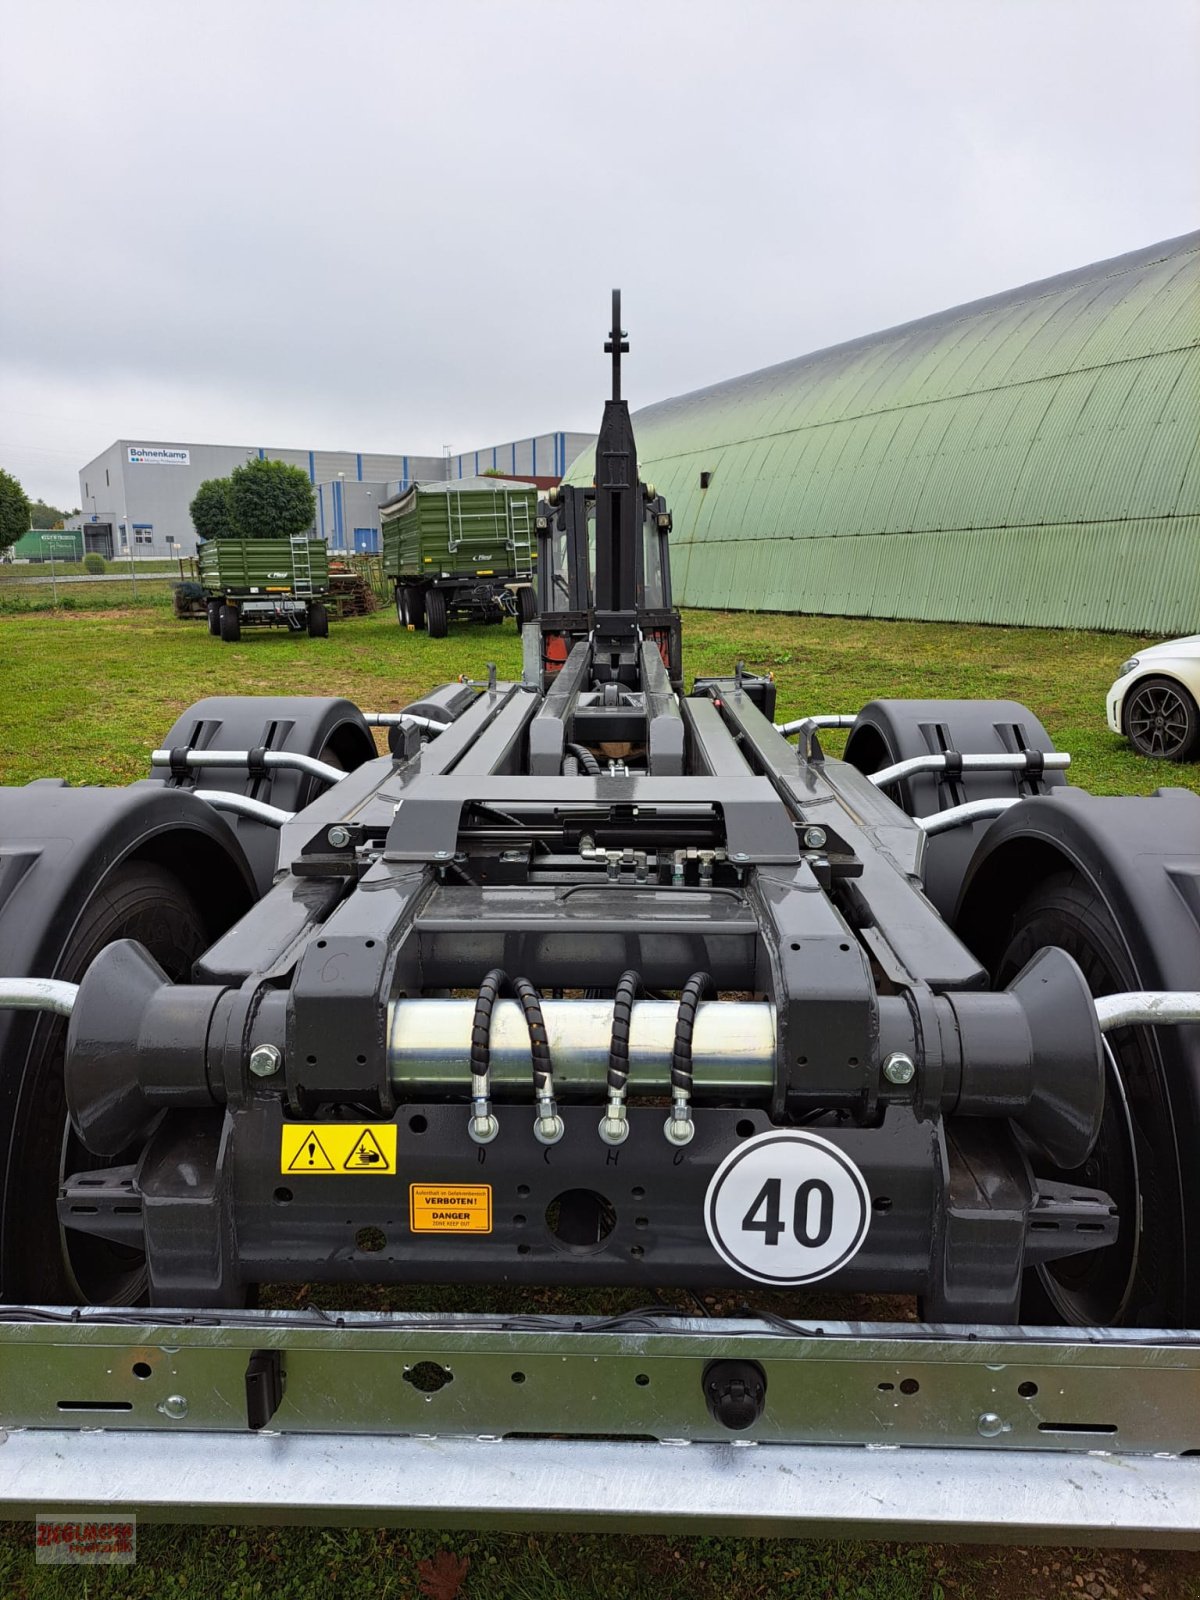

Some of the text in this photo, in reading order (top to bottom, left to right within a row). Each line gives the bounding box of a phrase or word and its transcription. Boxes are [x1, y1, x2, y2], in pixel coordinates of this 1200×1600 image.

[130, 448, 187, 459] Bohnenkamp
[477, 1147, 486, 1165] D
[606, 1149, 619, 1166] H
[741, 1177, 834, 1249] 40
